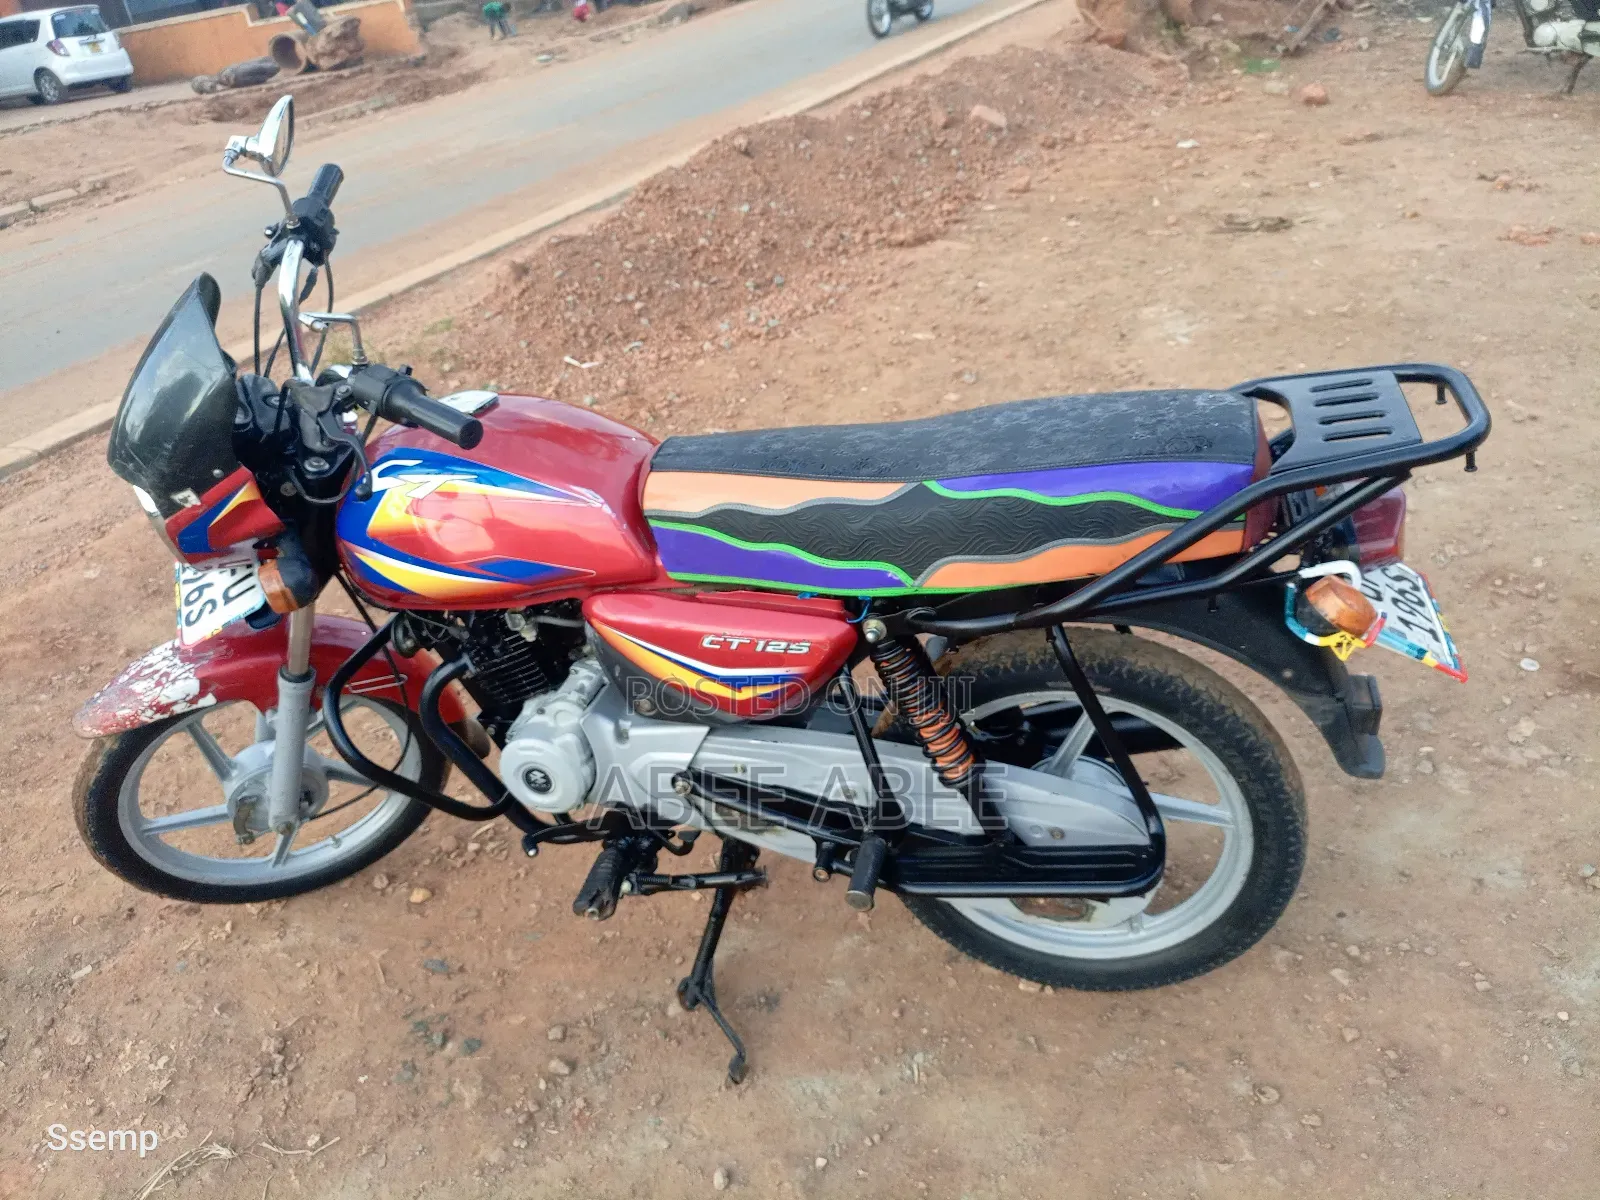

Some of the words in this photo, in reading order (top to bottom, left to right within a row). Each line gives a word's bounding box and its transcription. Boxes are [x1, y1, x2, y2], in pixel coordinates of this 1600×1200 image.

[1380, 566, 1441, 643] 196S
[701, 634, 751, 650] CT
[754, 639, 812, 654] 125
